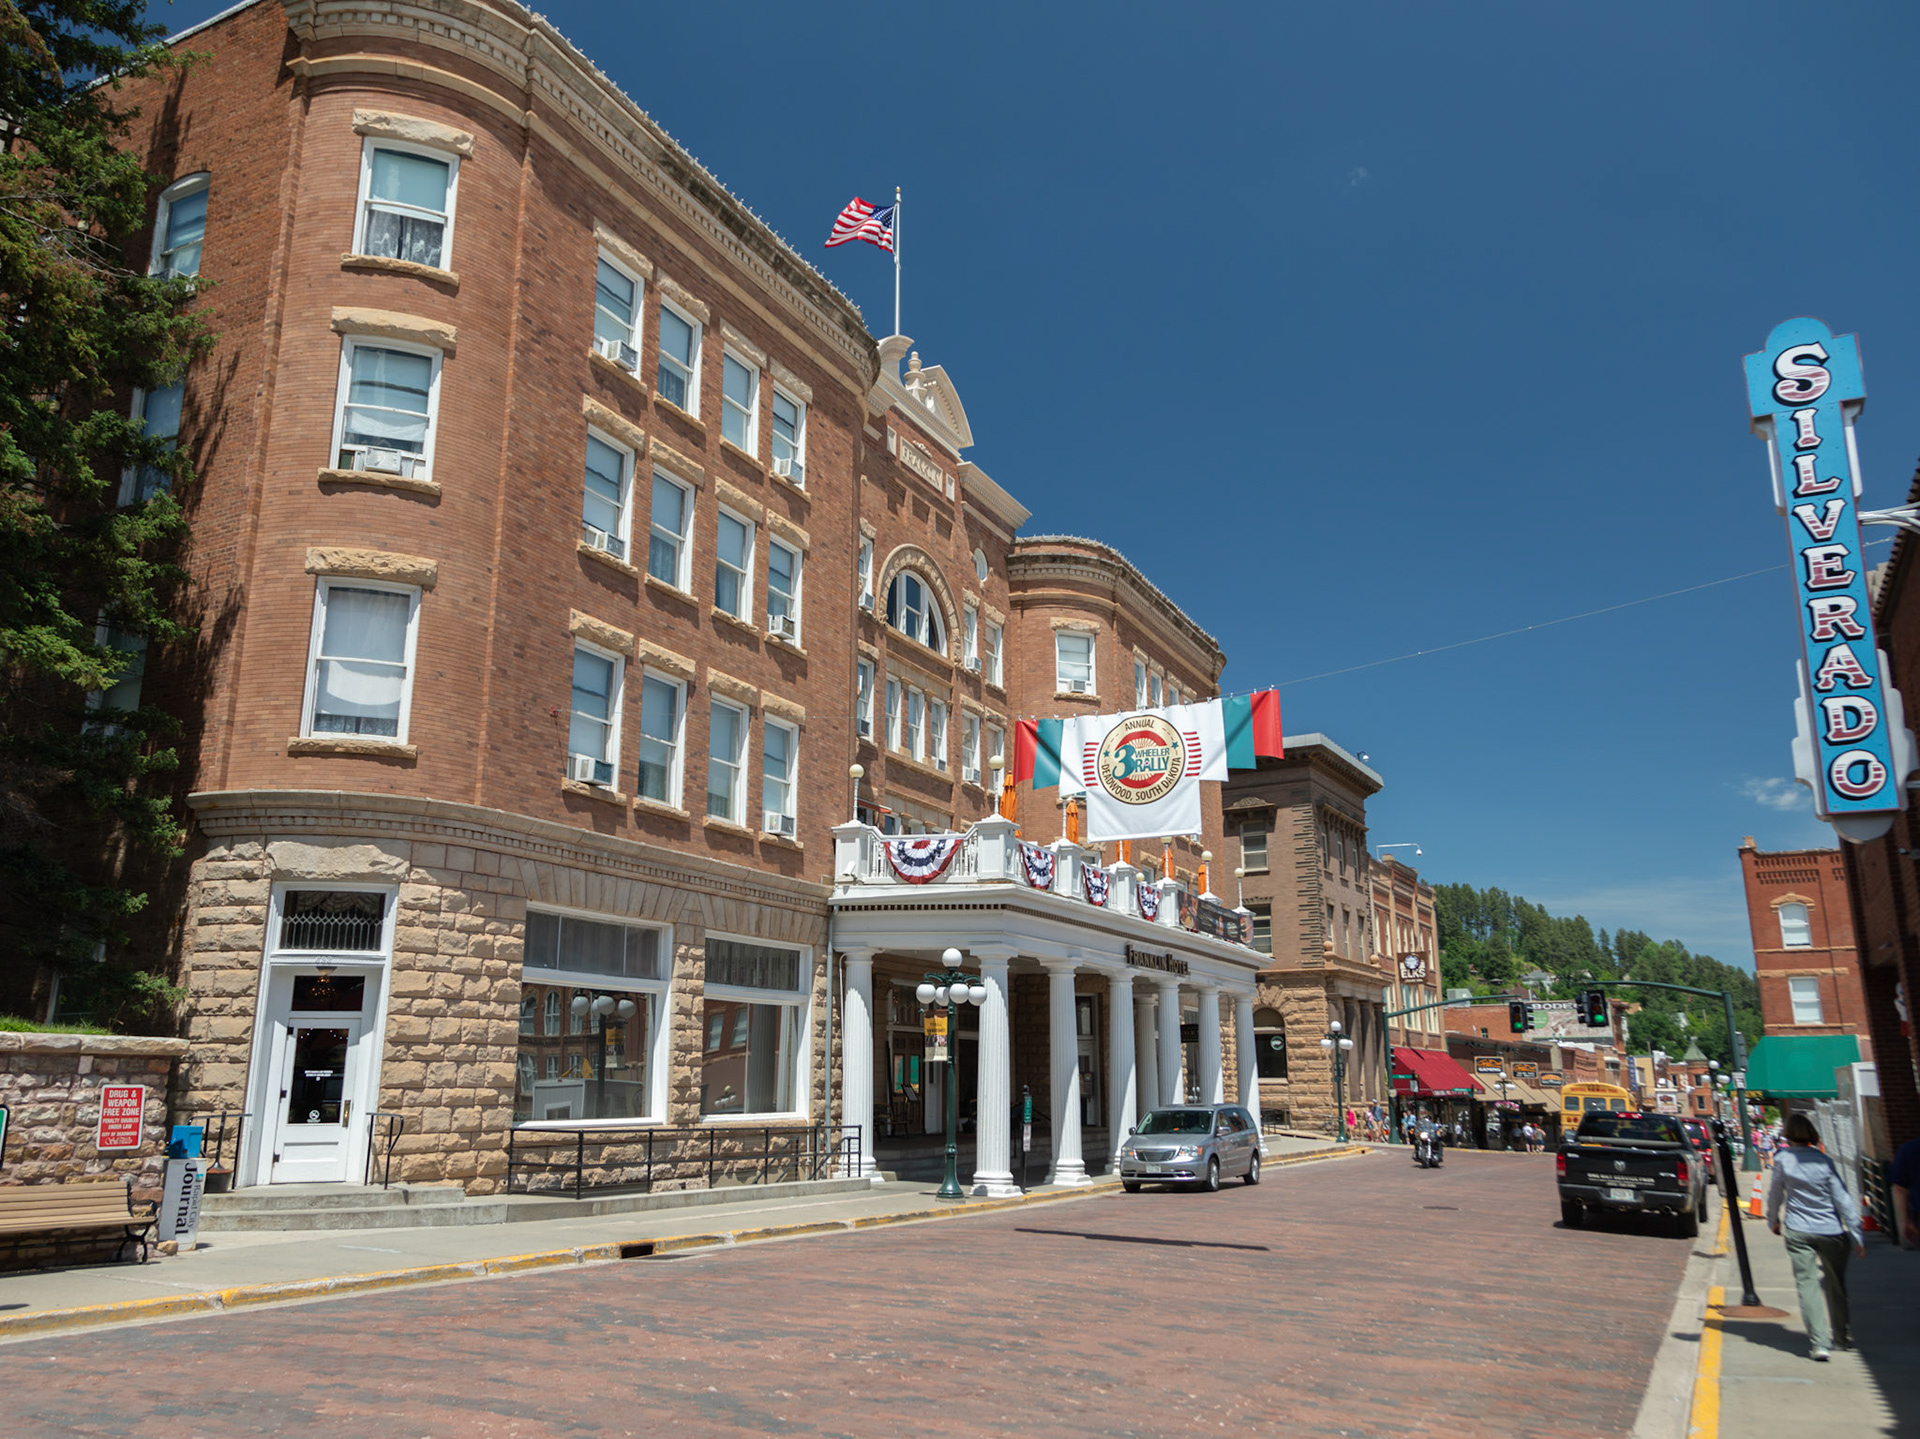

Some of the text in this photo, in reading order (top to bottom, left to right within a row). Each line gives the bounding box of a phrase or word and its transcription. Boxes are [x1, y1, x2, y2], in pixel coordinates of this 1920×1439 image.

[1773, 341, 1887, 799] SILVERADO
[1125, 719, 1155, 731] ANNUAL
[1112, 744, 1170, 780] 3 WHEELER
[1135, 756, 1170, 773] RALLY
[1101, 756, 1181, 801] DEADWOOD, SOUTH DAKOTA
[1400, 968, 1426, 979] ELKS
[109, 1090, 136, 1098] DRUG &
[108, 1099, 137, 1107] WEAPON
[103, 1108, 139, 1116] FREE ZONE
[175, 1162, 197, 1235] Journal
[187, 1185, 200, 1229] Rapid City
